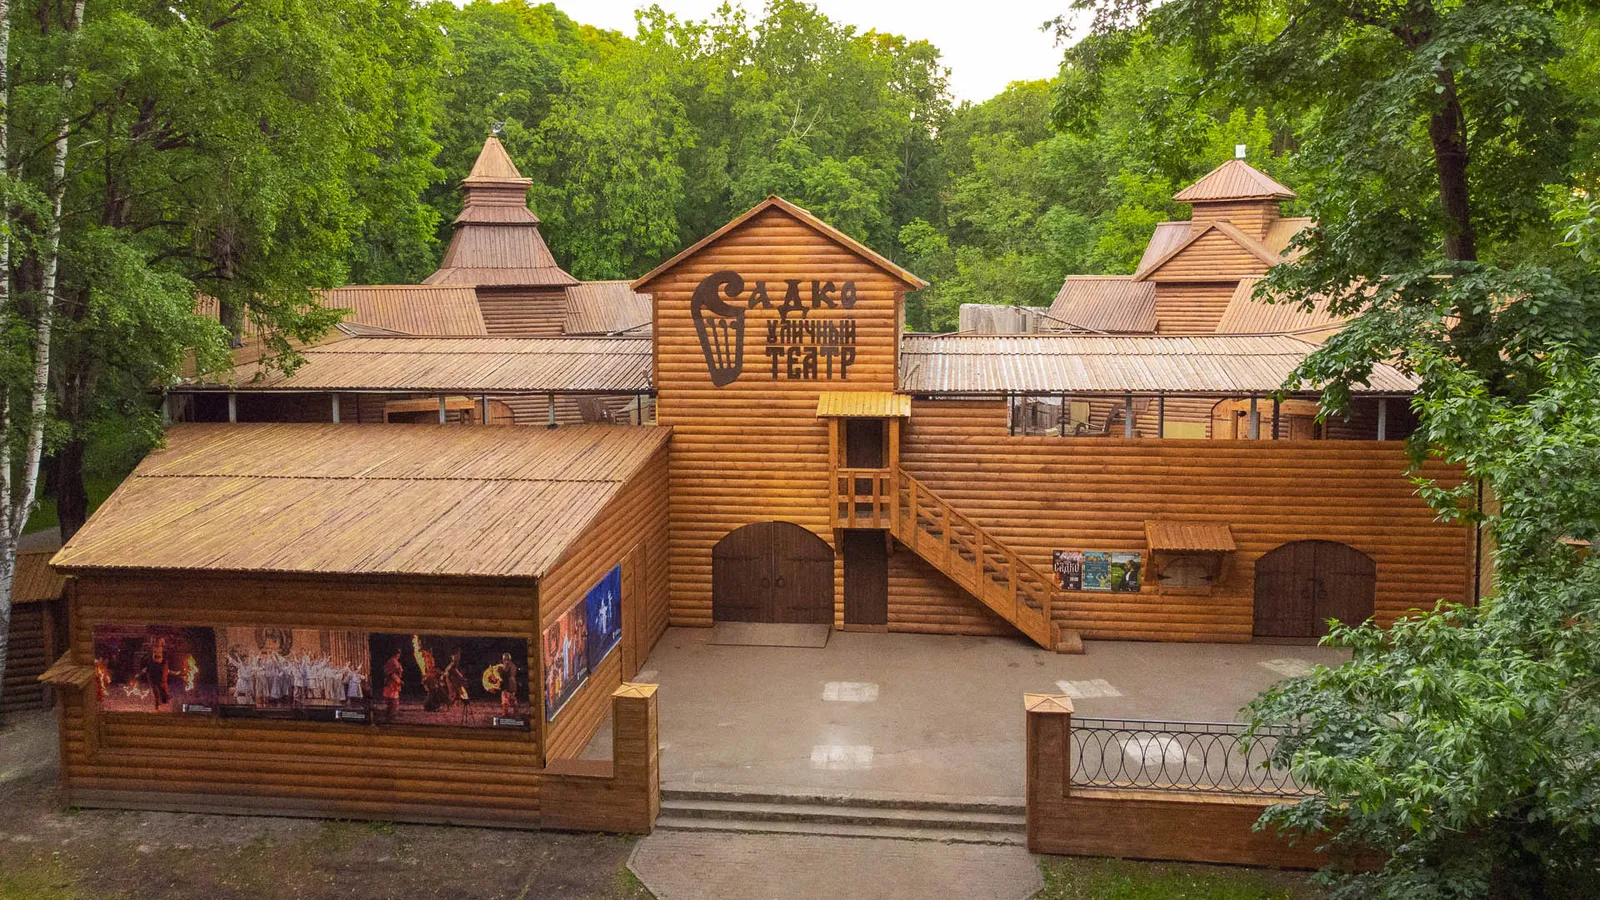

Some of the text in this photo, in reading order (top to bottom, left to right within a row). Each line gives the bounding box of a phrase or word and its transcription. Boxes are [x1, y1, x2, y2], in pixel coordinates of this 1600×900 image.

[691, 270, 857, 325] САДКО
[766, 315, 856, 345] УЛИЧНЫЙ
[765, 347, 856, 379] ТЕАТР
